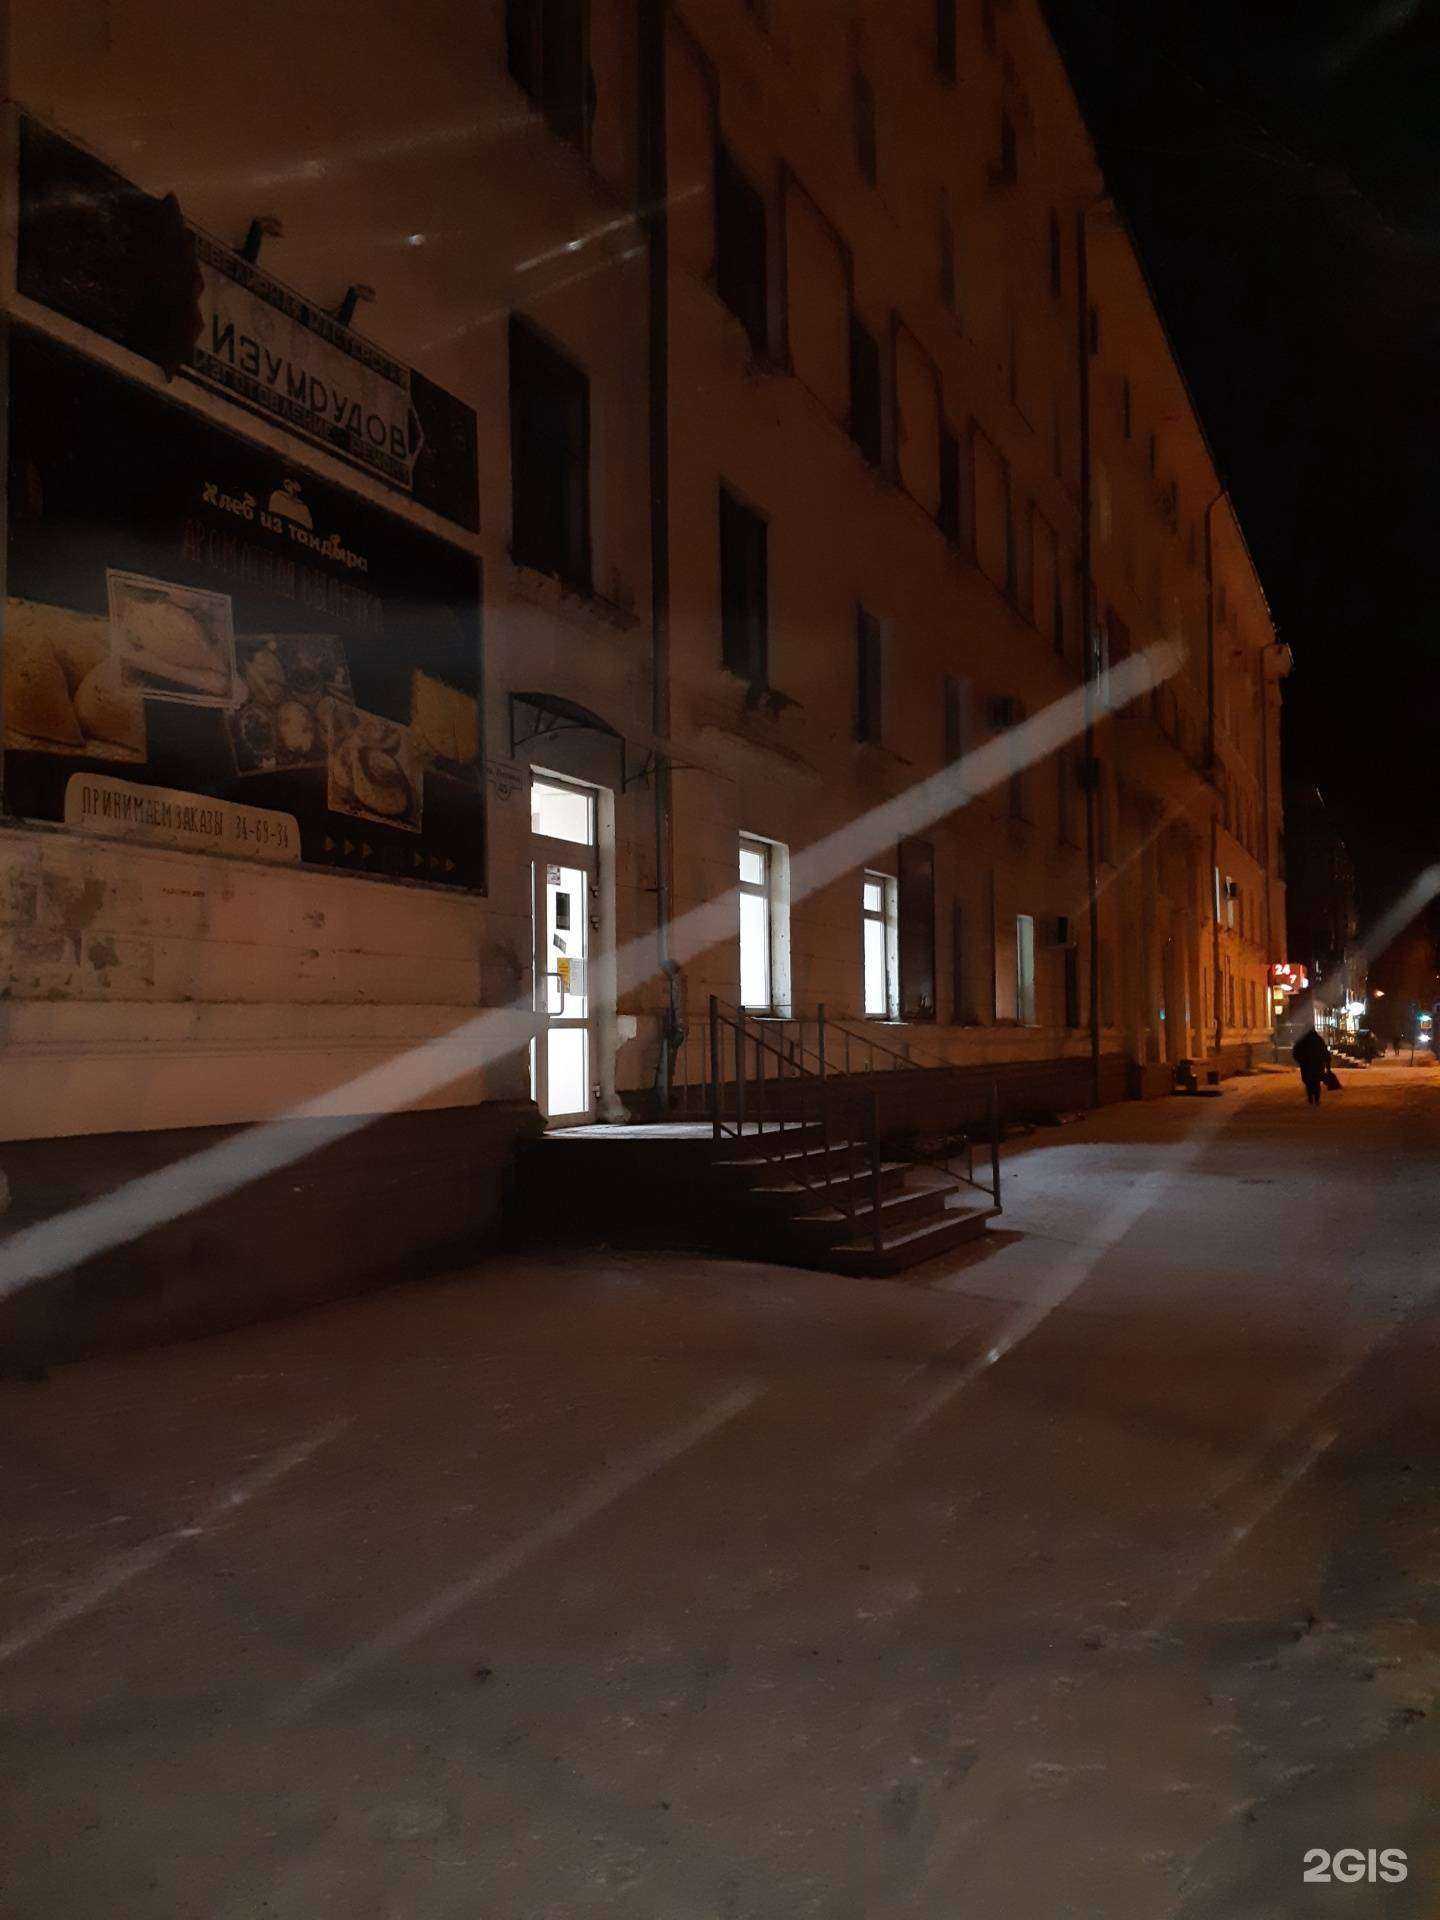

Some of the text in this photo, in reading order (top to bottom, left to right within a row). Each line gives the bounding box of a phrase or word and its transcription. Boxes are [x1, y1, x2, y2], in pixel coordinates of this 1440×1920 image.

[213, 313, 406, 459] ИЗУМРУДОВ
[201, 480, 368, 570] Хлеб из тандыра
[83, 786, 172, 829] ПРИНИМАЕМ
[175, 805, 224, 836] ЗАКАЗЫ
